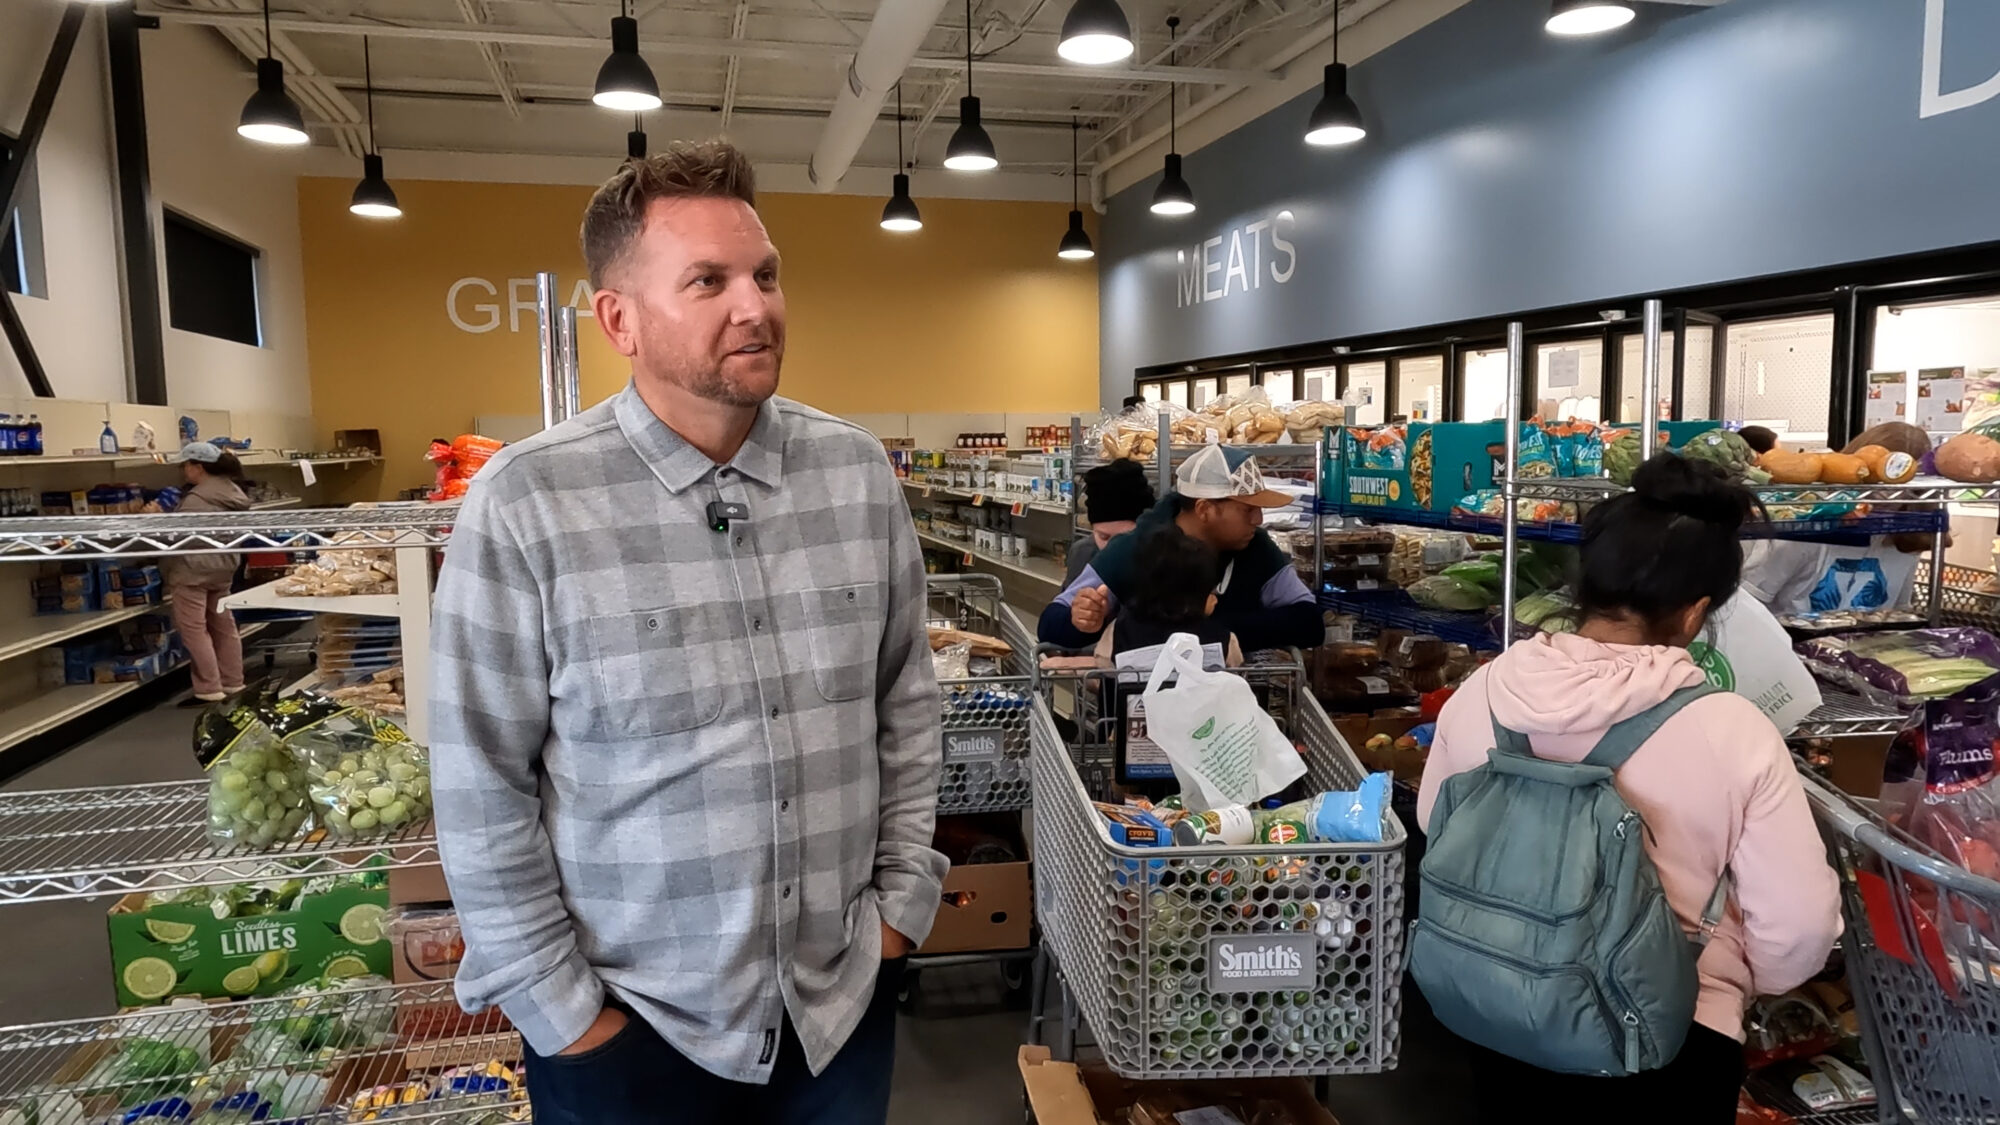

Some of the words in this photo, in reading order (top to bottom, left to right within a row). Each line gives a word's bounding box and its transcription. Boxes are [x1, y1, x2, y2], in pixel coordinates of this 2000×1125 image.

[1177, 210, 1296, 308] MEATS
[1349, 476, 1388, 495] SOUTHWEST
[948, 735, 996, 752] Smith's
[233, 919, 282, 932] Seedless
[221, 926, 297, 955] LIMES
[1219, 943, 1302, 970] Smith's
[1222, 970, 1242, 978] FOOD
[1250, 969, 1270, 977] DRUG
[1271, 969, 1299, 977] STORES
